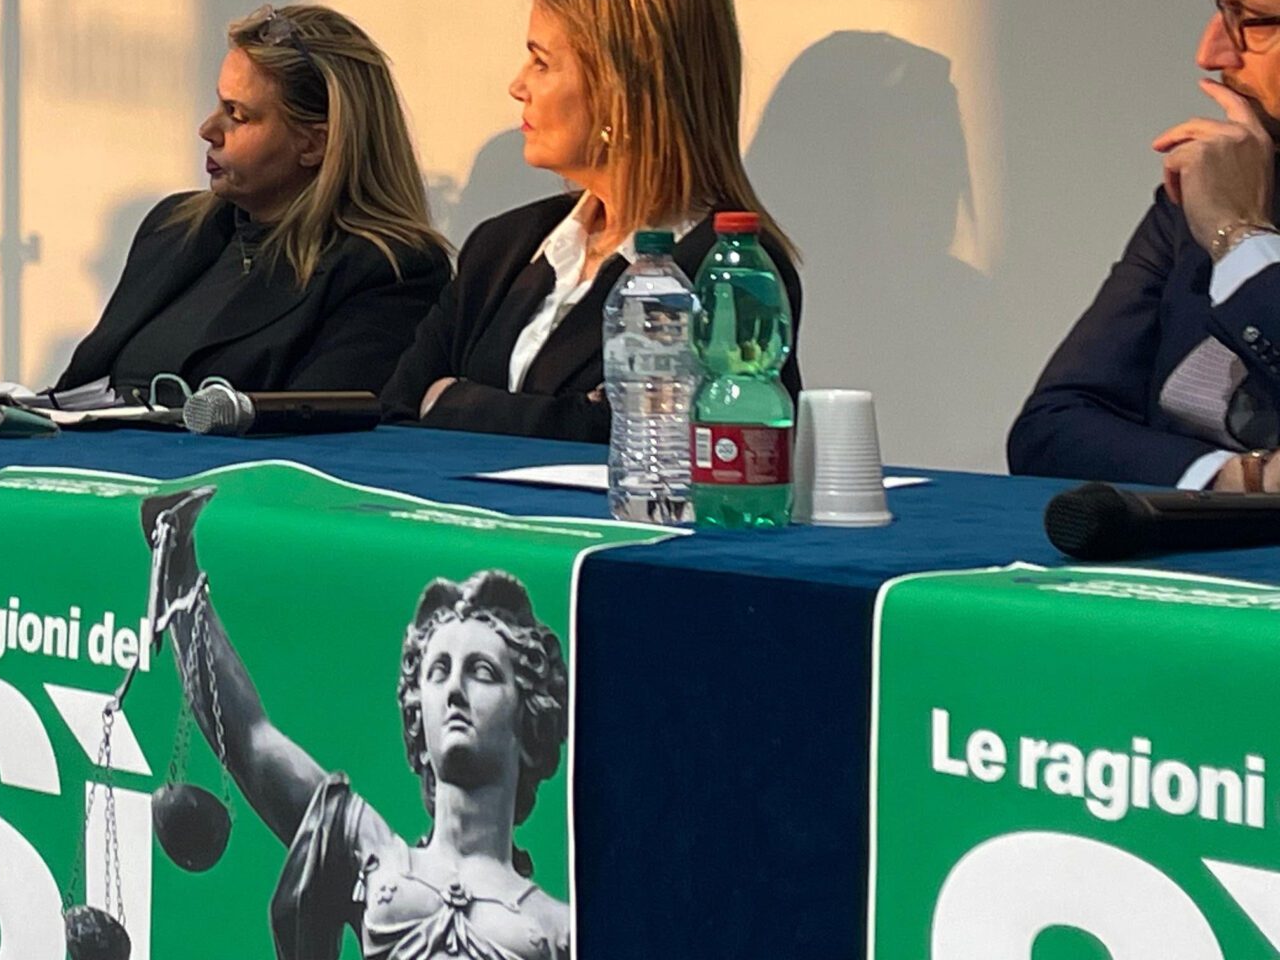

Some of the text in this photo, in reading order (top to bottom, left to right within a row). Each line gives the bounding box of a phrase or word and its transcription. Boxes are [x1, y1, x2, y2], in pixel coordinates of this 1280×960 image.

[88, 611, 151, 672] del
[932, 707, 1266, 829] Le ragioni
